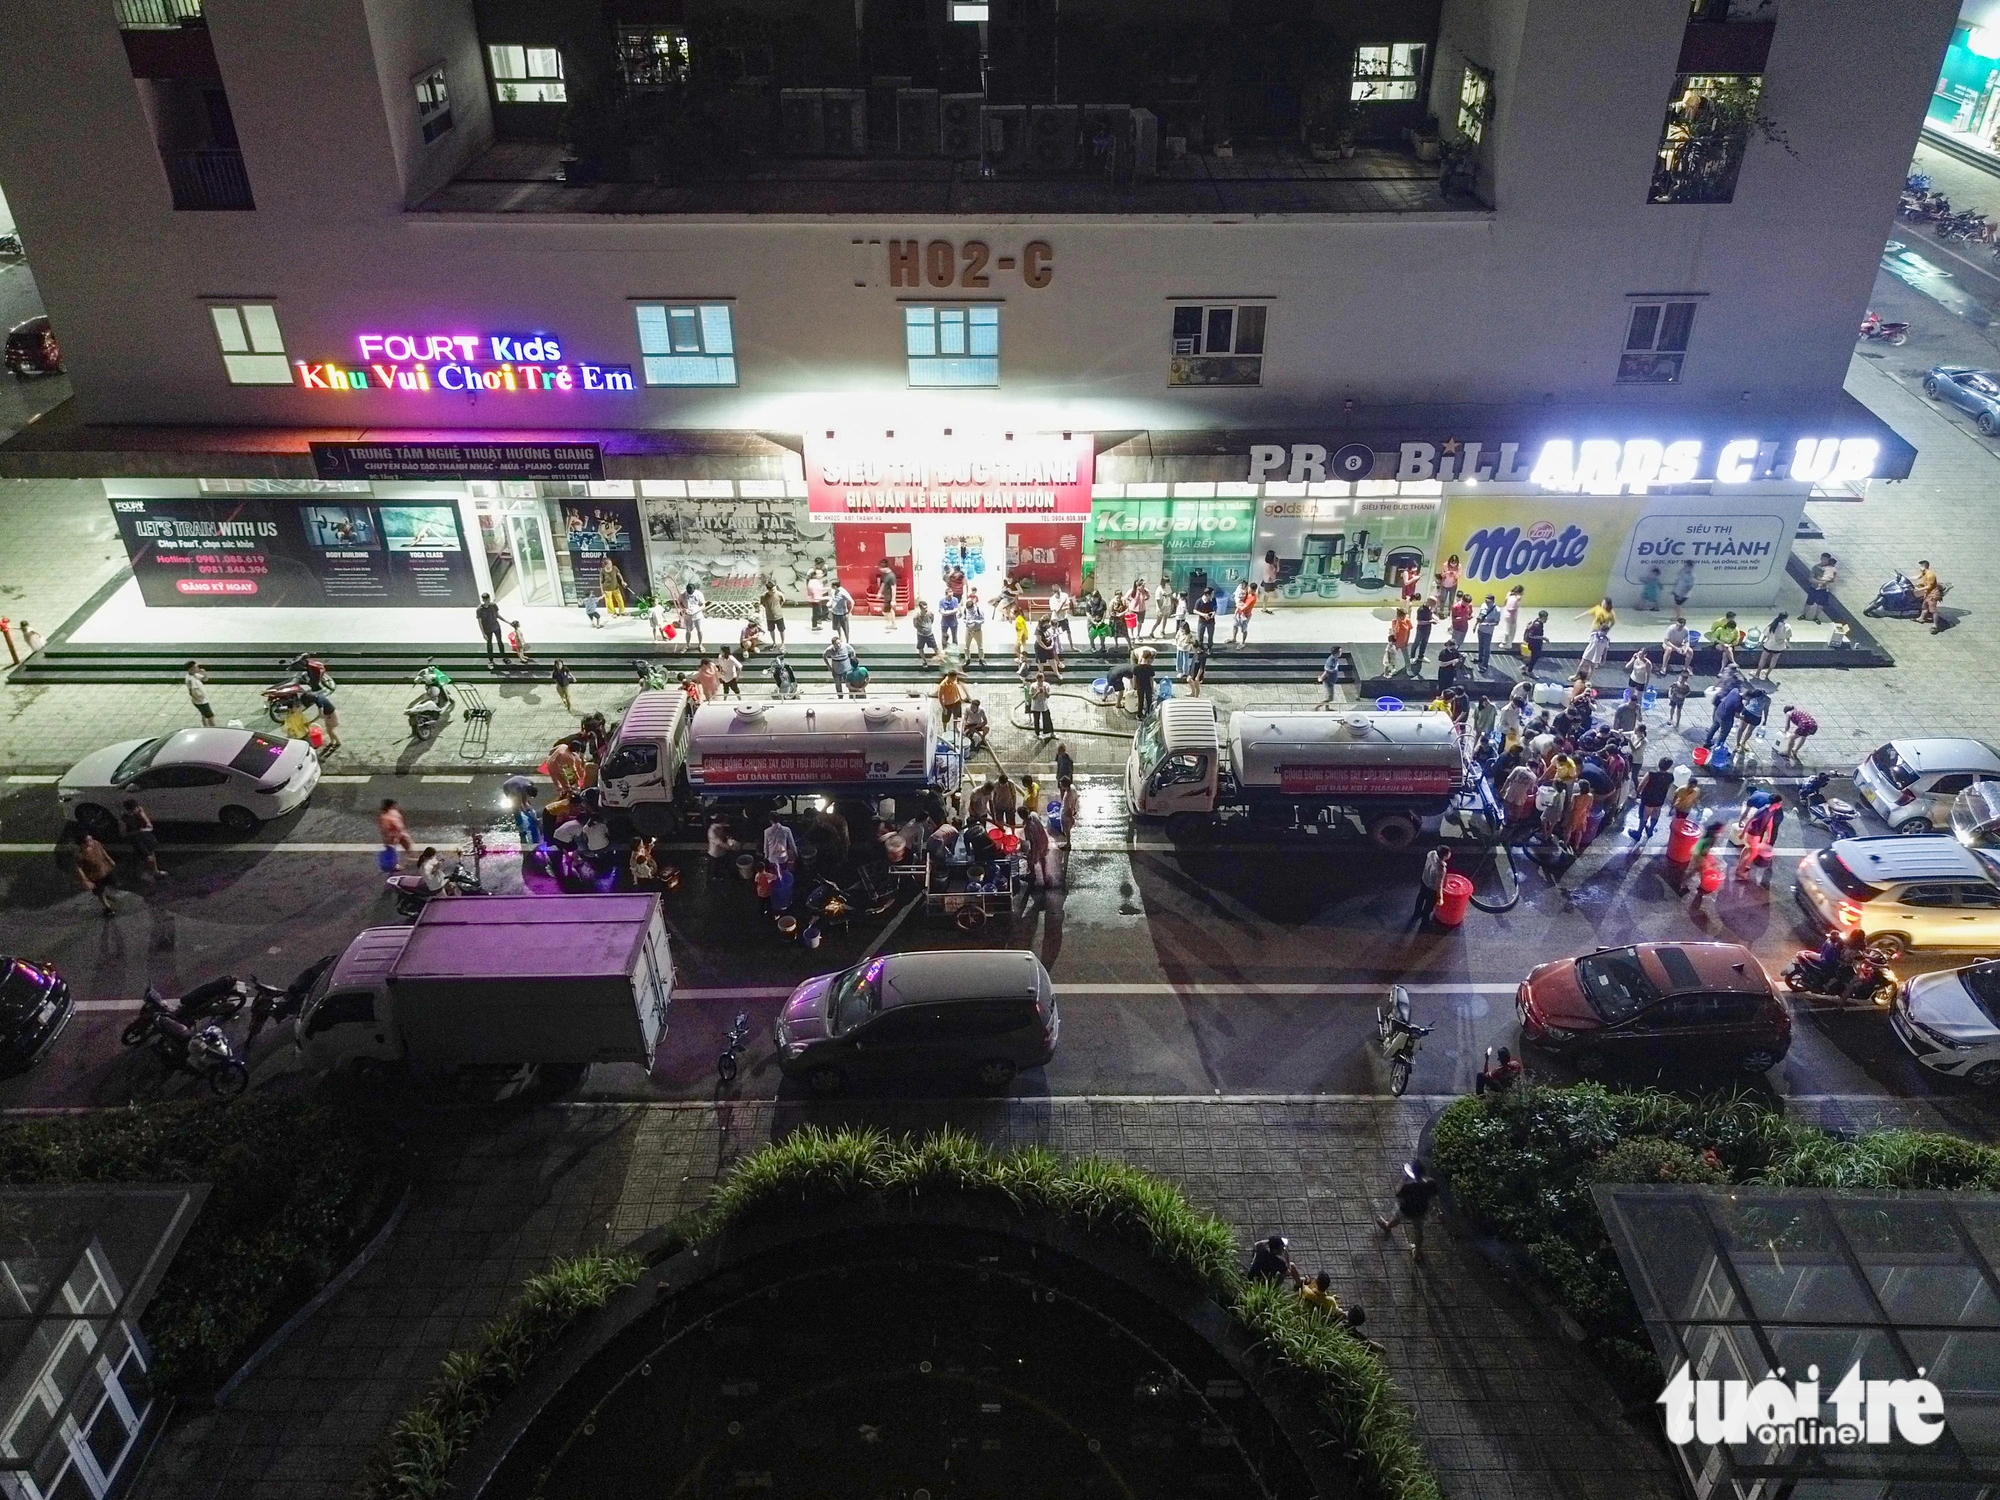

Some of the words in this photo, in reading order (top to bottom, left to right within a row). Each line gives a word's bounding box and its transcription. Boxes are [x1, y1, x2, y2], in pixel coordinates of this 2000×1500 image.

[359, 335, 479, 361] FOURT
[491, 336, 562, 361] Kids
[298, 363, 369, 390] Khu
[372, 363, 430, 390] Vui
[437, 362, 517, 391] Chơi
[518, 364, 573, 391] Trẻ
[348, 448, 393, 460] TRUNG
[395, 444, 425, 460] TÂM
[426, 445, 461, 462] NGHỆ
[463, 445, 503, 462] THUẬT
[506, 447, 552, 460] HƯƠNG
[553, 448, 595, 460] GIANG
[364, 461, 400, 470] CHUYÊN
[401, 461, 419, 470] ĐÀO
[469, 463, 494, 472] NHẠC
[500, 461, 520, 470] MÚA
[1715, 439, 1881, 484] CLUB
[136, 520, 173, 537] LET'S
[173, 521, 218, 537] TRAIN
[217, 521, 256, 537] WITH
[258, 522, 278, 537] US
[696, 516, 725, 529] HTX
[727, 516, 759, 529] ANH
[1096, 511, 1237, 536] Kangaroo
[1686, 524, 1711, 534] SIÊU
[1714, 525, 1733, 536] THỊ
[1167, 539, 1190, 548] NHÀ
[1193, 537, 1216, 548] BẾP
[1637, 537, 1686, 556] ĐỨC
[1692, 537, 1771, 556] THÀNH
[157, 555, 194, 564] Hotline:
[1464, 524, 1589, 582] Monte
[199, 565, 268, 574] 0981.848.396
[181, 582, 210, 591] ĐĂNG
[227, 583, 253, 591] NGAY
[830, 758, 848, 771] SẠCH
[850, 758, 863, 769] CHO
[790, 773, 818, 781] THANH
[1370, 784, 1400, 792] THANH
